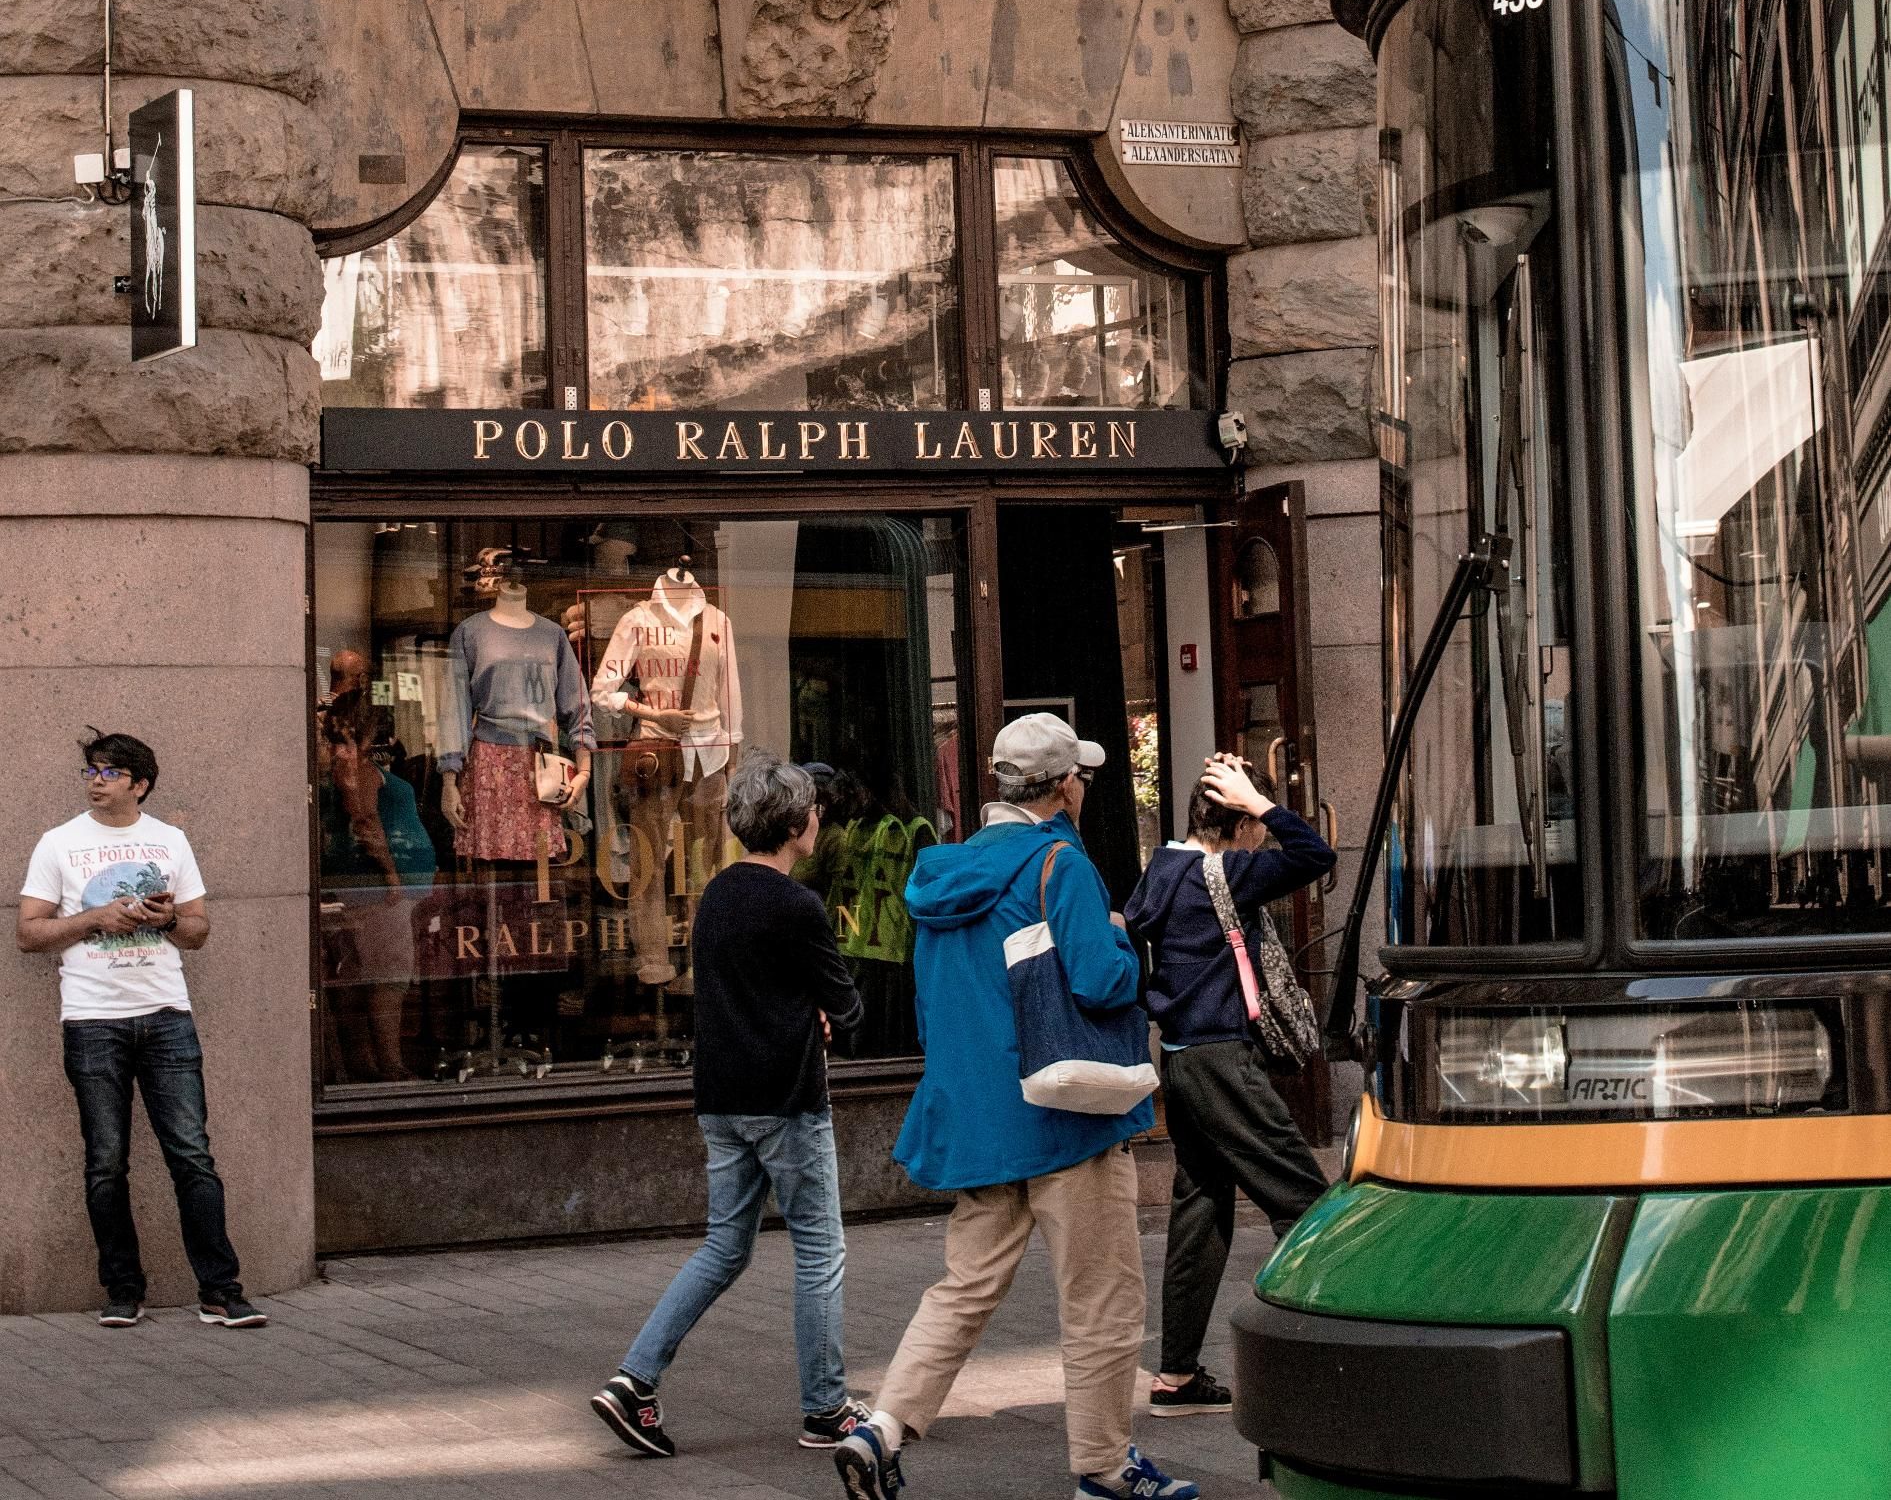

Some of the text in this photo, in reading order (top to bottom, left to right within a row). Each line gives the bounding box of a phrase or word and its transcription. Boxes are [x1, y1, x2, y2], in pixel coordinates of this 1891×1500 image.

[1131, 145, 1235, 164] ALEXANDERSGATAN
[472, 419, 1139, 461] POLO RALPH LAUREN
[631, 626, 676, 646] THE
[605, 657, 702, 680] SUMMER
[626, 689, 684, 711] SALE
[69, 852, 95, 868] U.S.
[98, 848, 136, 864] POLO
[139, 847, 173, 861] ASSN.
[532, 821, 716, 904] POL
[455, 917, 629, 960] RALPH
[118, 947, 135, 958] Kea
[136, 947, 155, 957] Polo
[1572, 1077, 1648, 1100] ARTIC
